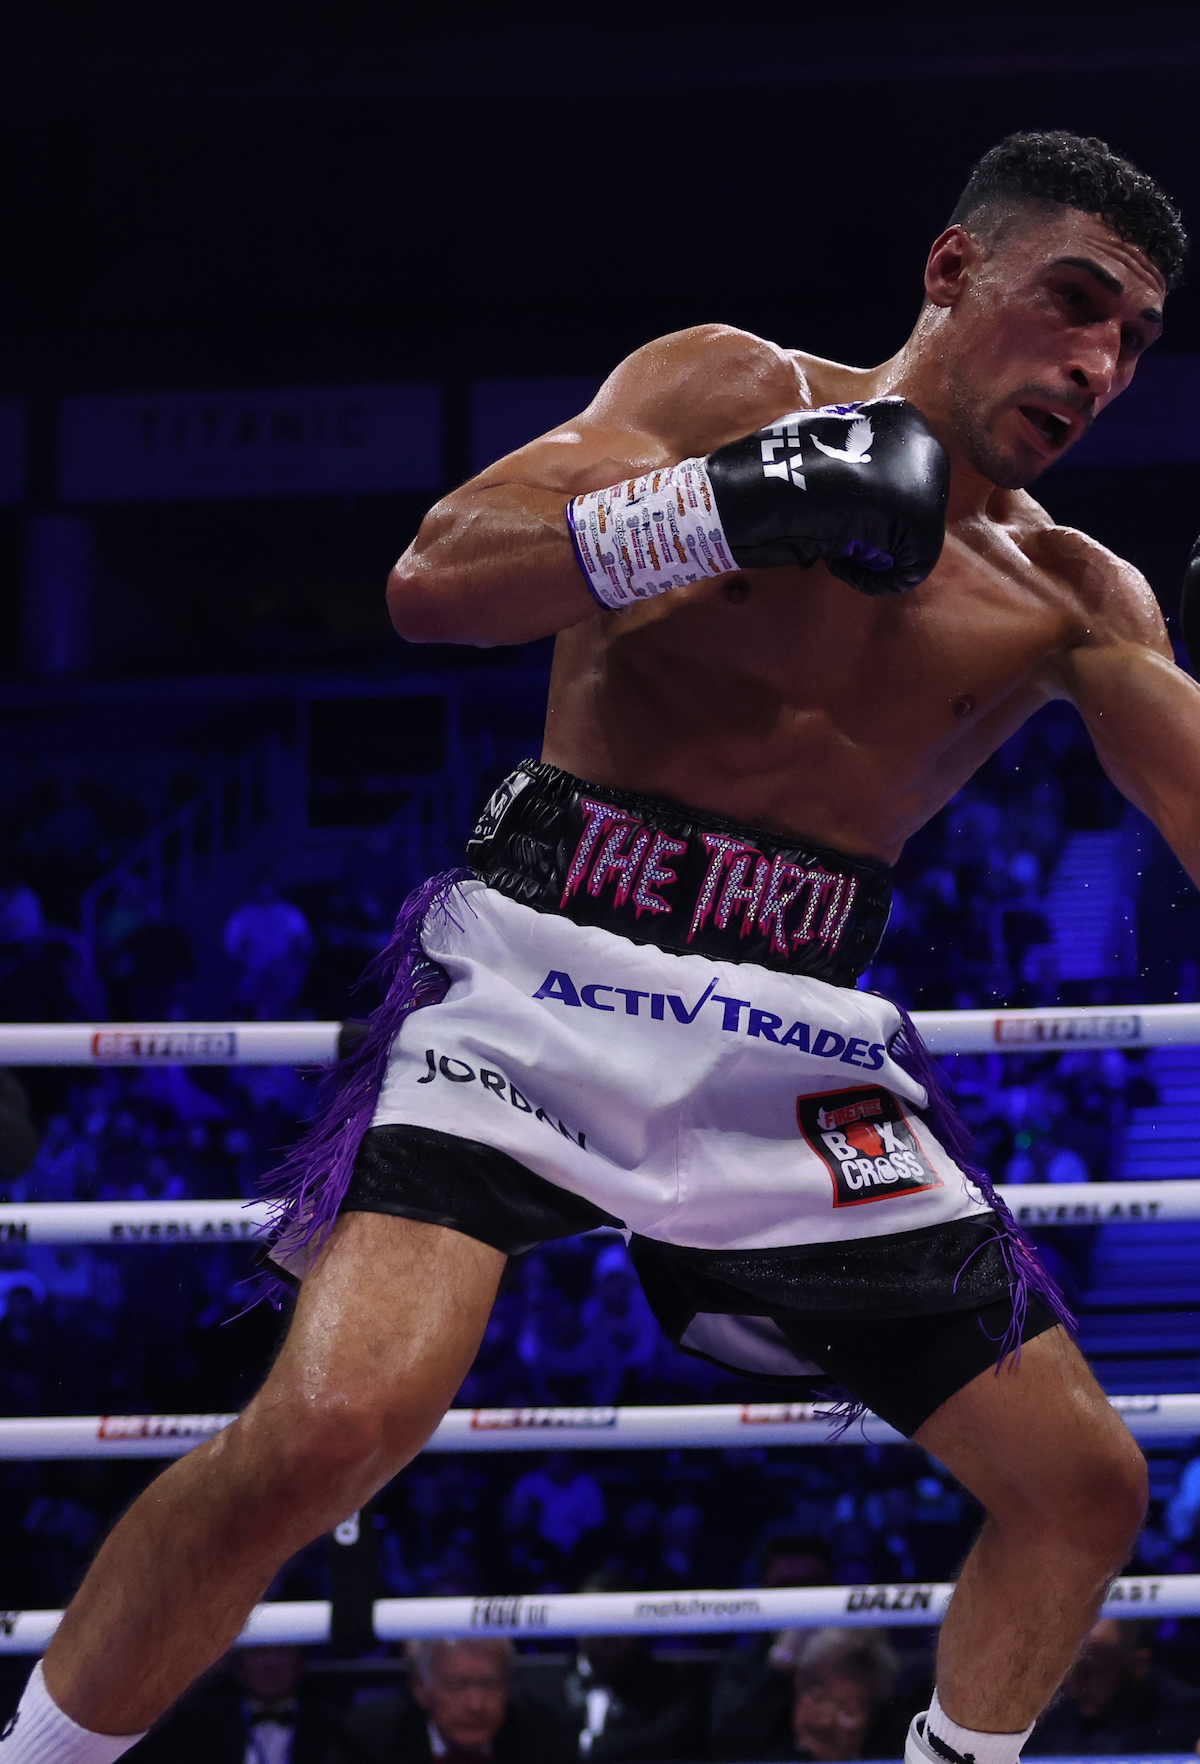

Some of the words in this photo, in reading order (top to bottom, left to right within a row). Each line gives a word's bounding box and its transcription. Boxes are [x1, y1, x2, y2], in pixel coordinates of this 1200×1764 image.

[139, 402, 368, 452] TITANIC
[760, 424, 807, 491] FLY
[558, 798, 688, 919] THE
[1018, 1202, 1162, 1220] EVERLAST
[845, 1586, 932, 1612] DAZN
